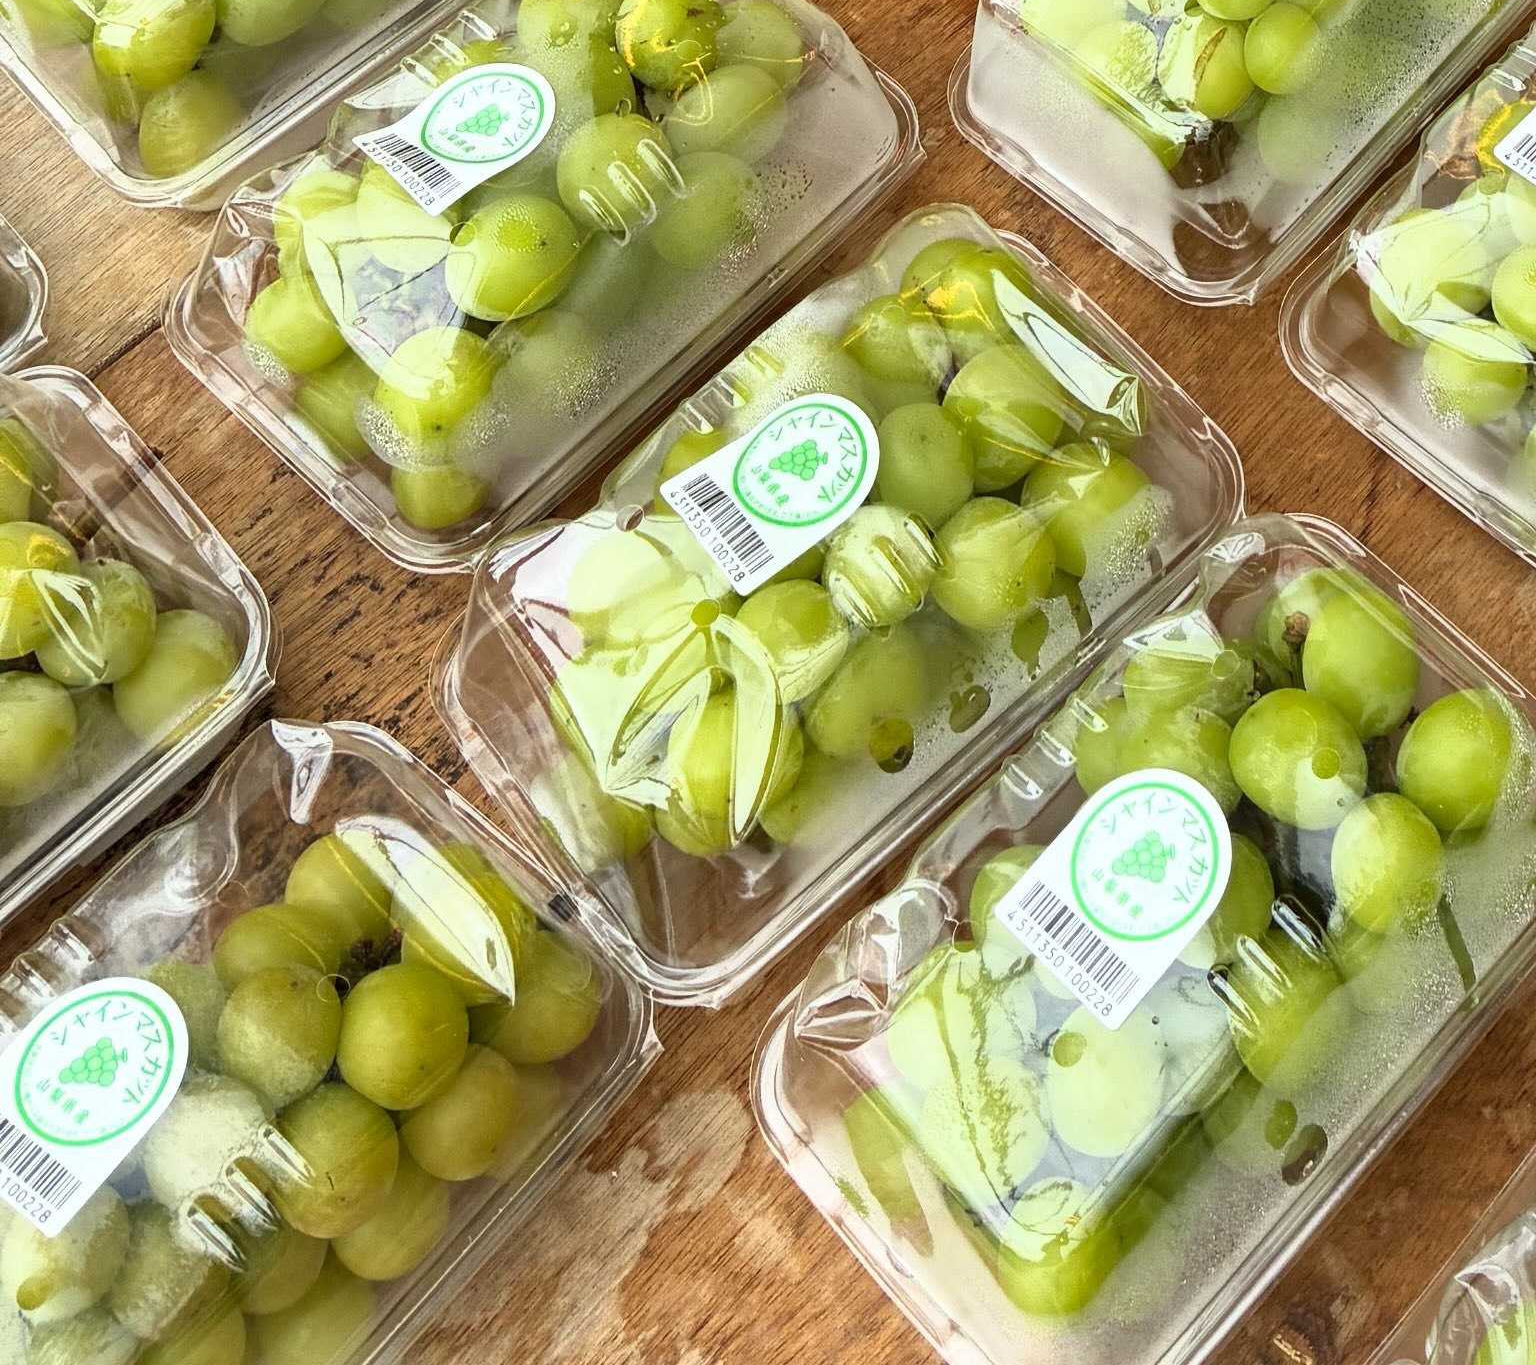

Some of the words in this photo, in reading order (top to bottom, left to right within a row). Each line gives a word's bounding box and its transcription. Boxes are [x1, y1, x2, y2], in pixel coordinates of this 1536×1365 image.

[452, 80, 537, 148] シャインマスカット
[770, 412, 856, 502] シャインマスカット
[1103, 792, 1211, 903] シャインマスカット
[1091, 869, 1142, 920] 山梨県産
[49, 1001, 164, 1104] シャインマスカット
